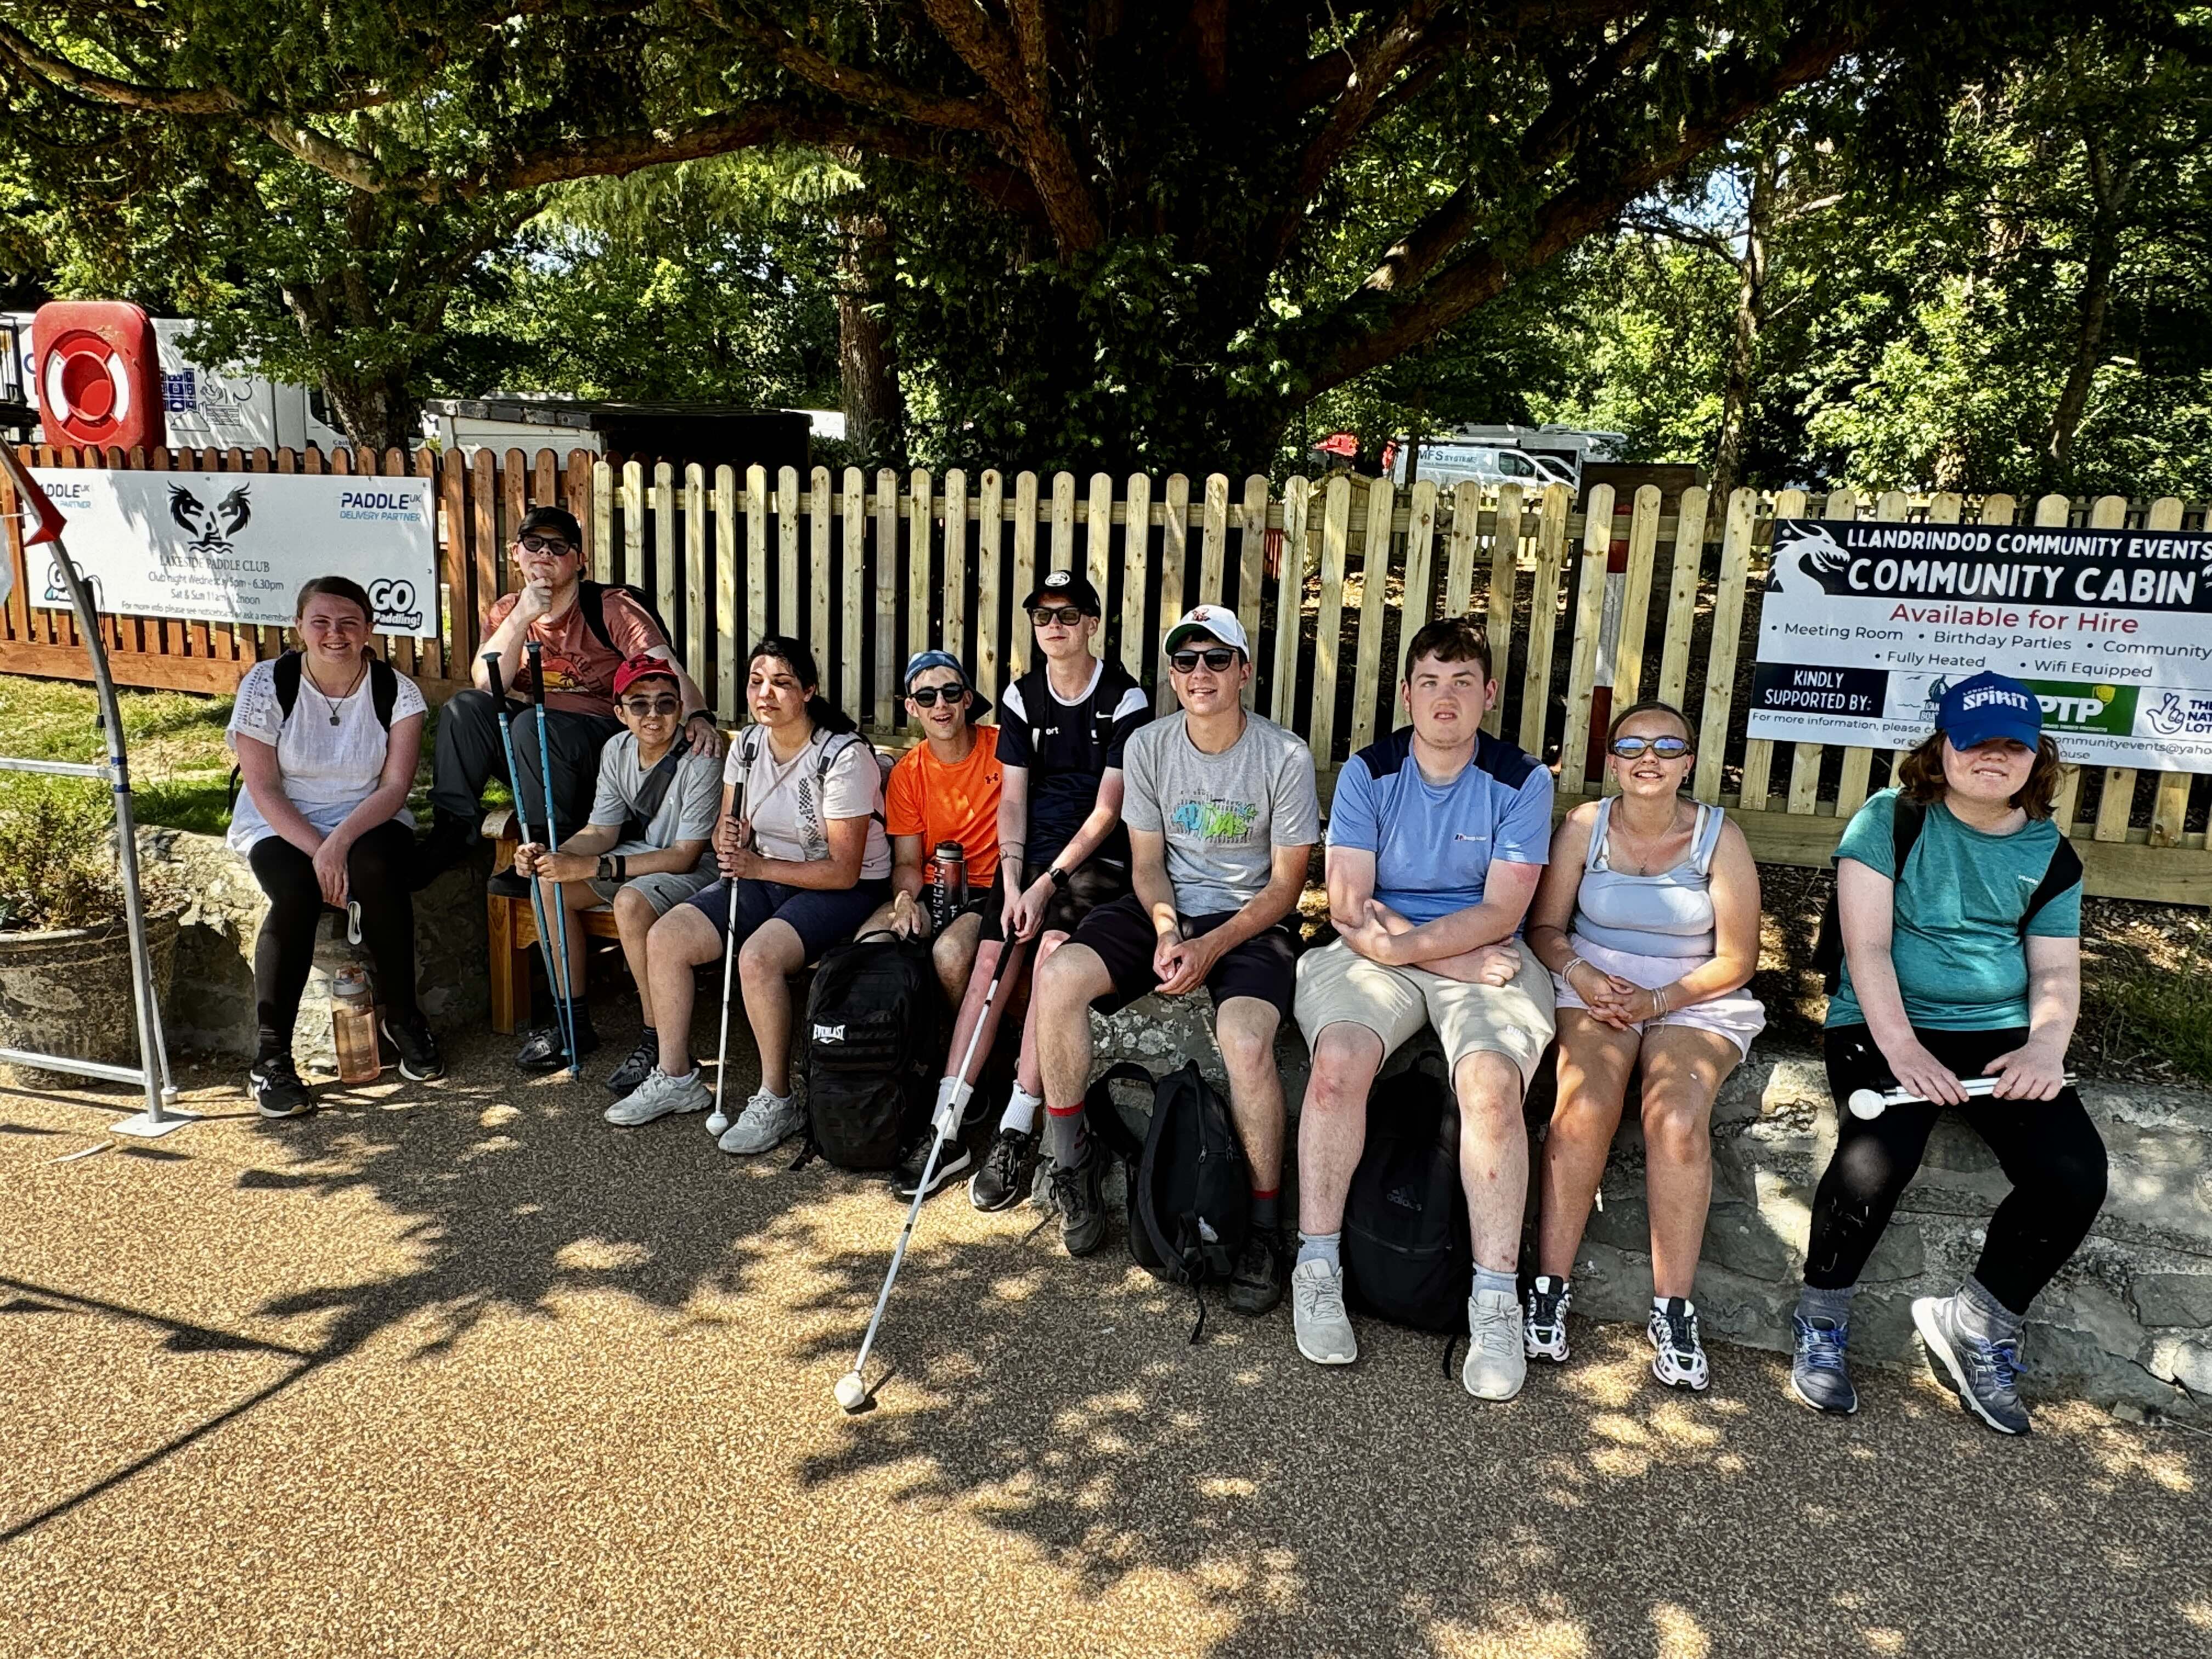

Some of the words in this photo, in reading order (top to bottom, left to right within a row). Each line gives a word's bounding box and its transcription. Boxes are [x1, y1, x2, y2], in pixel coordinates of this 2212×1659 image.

[341, 493, 409, 510] PADDLE
[340, 511, 379, 520] DELIVERY
[381, 512, 421, 522] PARTNER
[1847, 528, 1991, 552] LLANDRINDOD
[1996, 534, 2123, 557] COMMUNITY
[2128, 538, 2212, 560] EVENTS
[160, 554, 205, 568] LAKESIDE
[206, 555, 240, 571] PADDLE
[242, 560, 270, 573] CLUB
[148, 571, 166, 582] Club
[252, 579, 284, 592] 6.30pm
[1848, 558, 2065, 599] COMMUNITY
[2075, 567, 2197, 605] CABIN
[171, 588, 183, 598] Sat
[191, 590, 205, 600] Sun
[369, 579, 415, 612] GO
[373, 611, 421, 629] Paddling!
[1889, 603, 2020, 628] Available
[2028, 609, 2069, 630] for
[2077, 612, 2138, 634] Hire
[1785, 623, 1850, 640] Meeting
[1855, 627, 1903, 641] Room
[1934, 631, 2007, 649] Birthday
[2011, 635, 2072, 650] Parties
[2103, 640, 2212, 661] Community
[1887, 651, 1925, 667] Fully
[1928, 653, 1985, 668] Heated
[2034, 659, 2066, 673] Wifi
[2071, 662, 2153, 679] Equipped
[1793, 669, 1844, 689] KINDLY
[1764, 689, 1846, 709] SUPPORTED
[1849, 694, 1872, 712] BY:
[1752, 712, 1770, 721] For
[1774, 715, 1805, 725] more
[1807, 716, 1879, 732] information,
[1882, 723, 1921, 733] please
